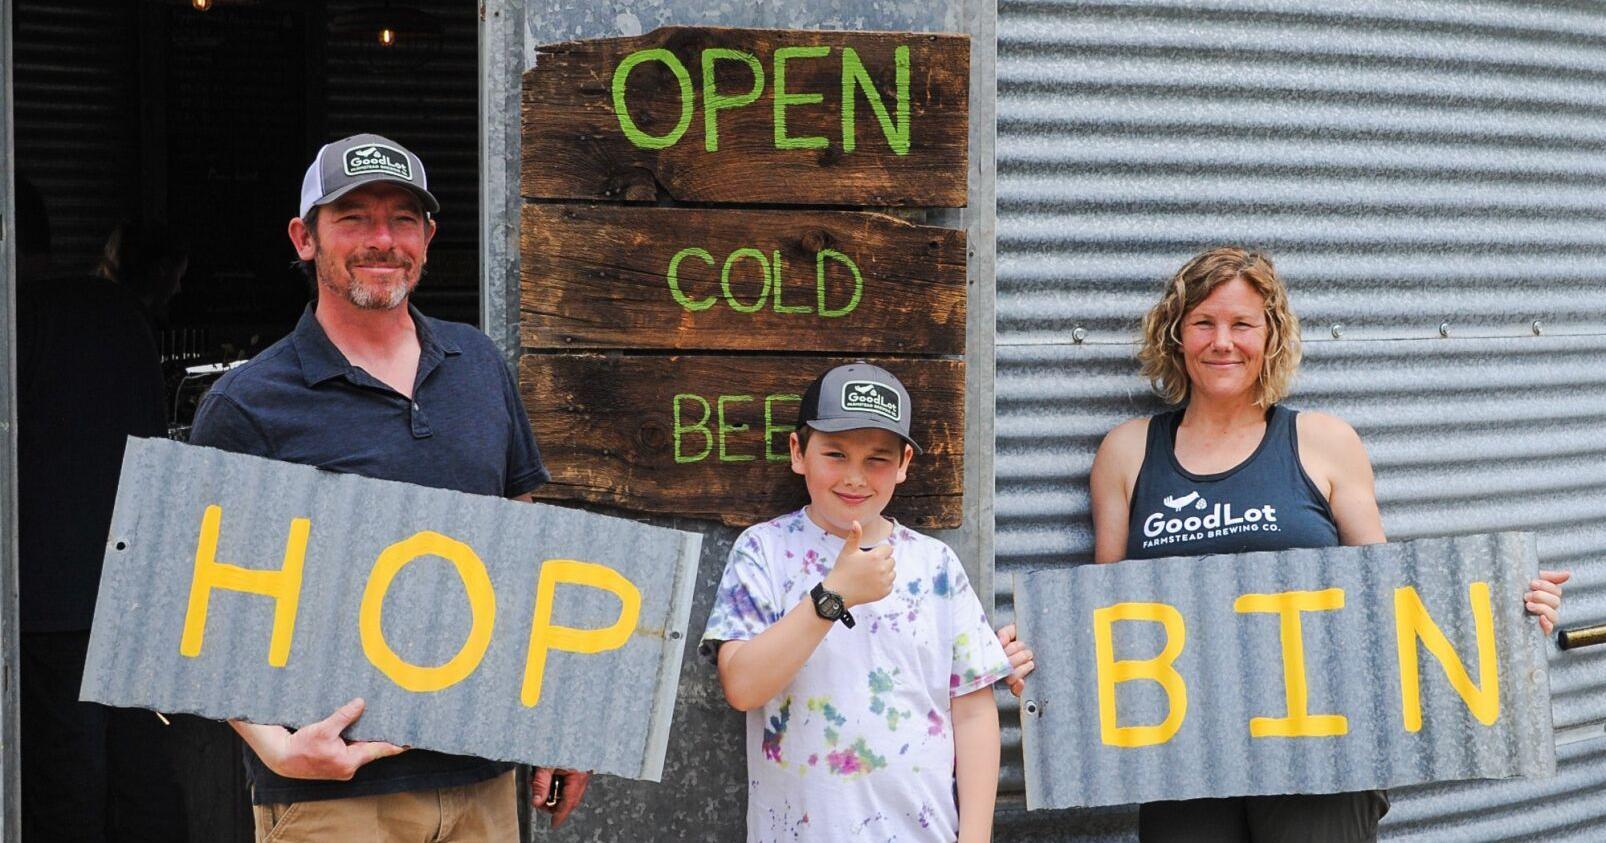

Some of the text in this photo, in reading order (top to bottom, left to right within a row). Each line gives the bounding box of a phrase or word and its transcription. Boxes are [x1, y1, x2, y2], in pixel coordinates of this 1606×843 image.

[611, 44, 912, 156] OPEN
[350, 155, 407, 172] GoodLot
[667, 247, 864, 318] COLD
[673, 394, 803, 464] BEE
[848, 392, 898, 412] GoodLot
[1142, 523, 1282, 549] FARMSTEAD BREWING CO.
[1143, 503, 1278, 538] GoodLot
[180, 504, 642, 707] HOP
[1093, 582, 1500, 748] BIN
